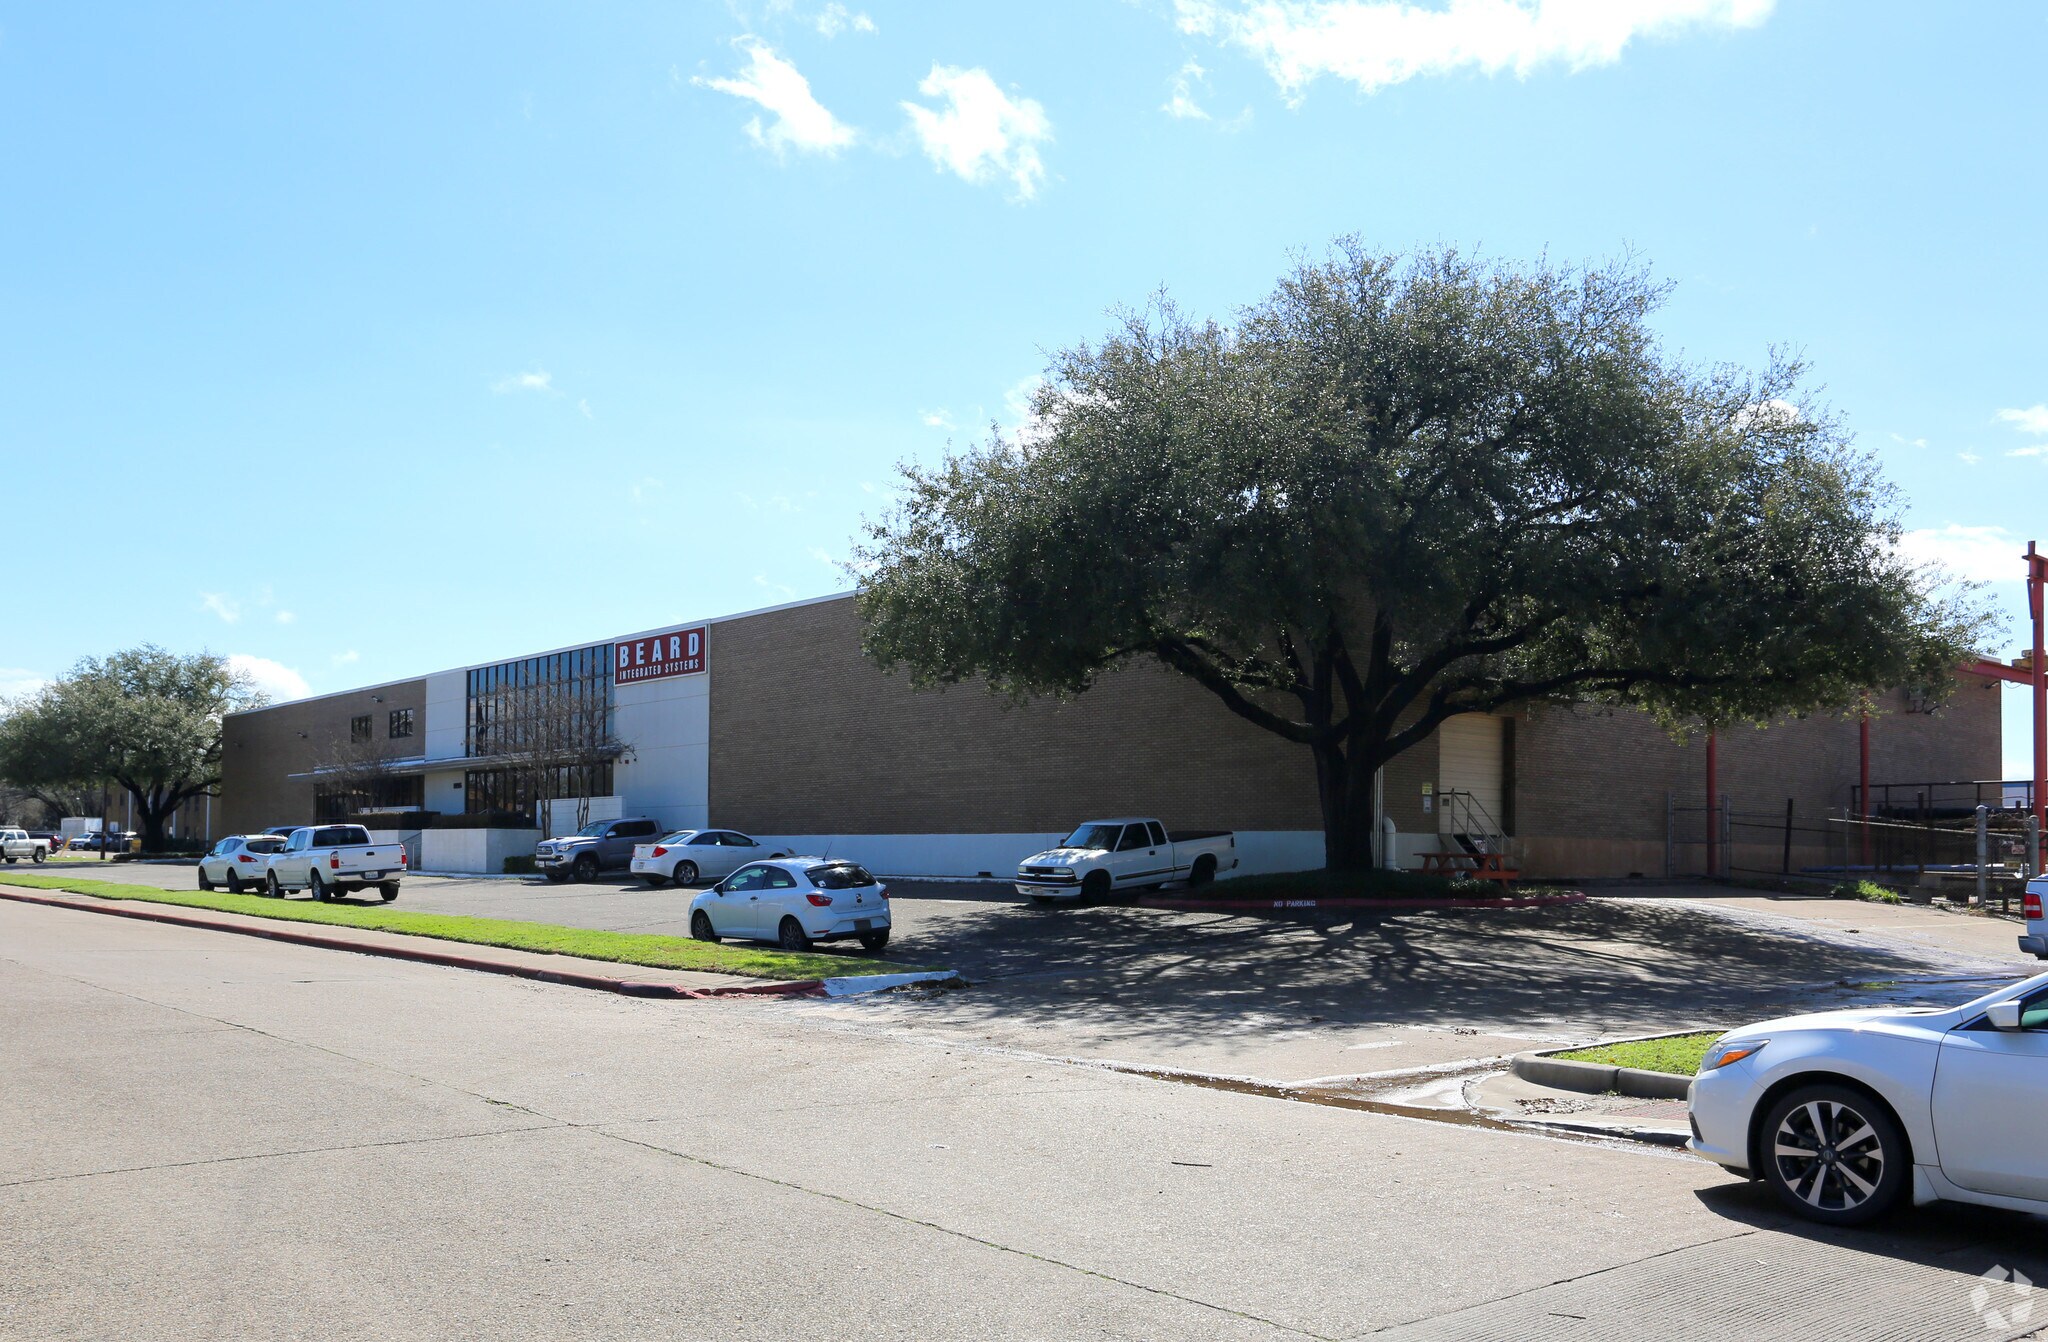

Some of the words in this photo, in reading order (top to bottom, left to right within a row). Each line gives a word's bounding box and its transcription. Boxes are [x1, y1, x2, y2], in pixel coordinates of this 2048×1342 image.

[620, 632, 699, 668] BEARD
[620, 665, 661, 680] INTEGRATED
[665, 658, 699, 673] SYSTEMS
